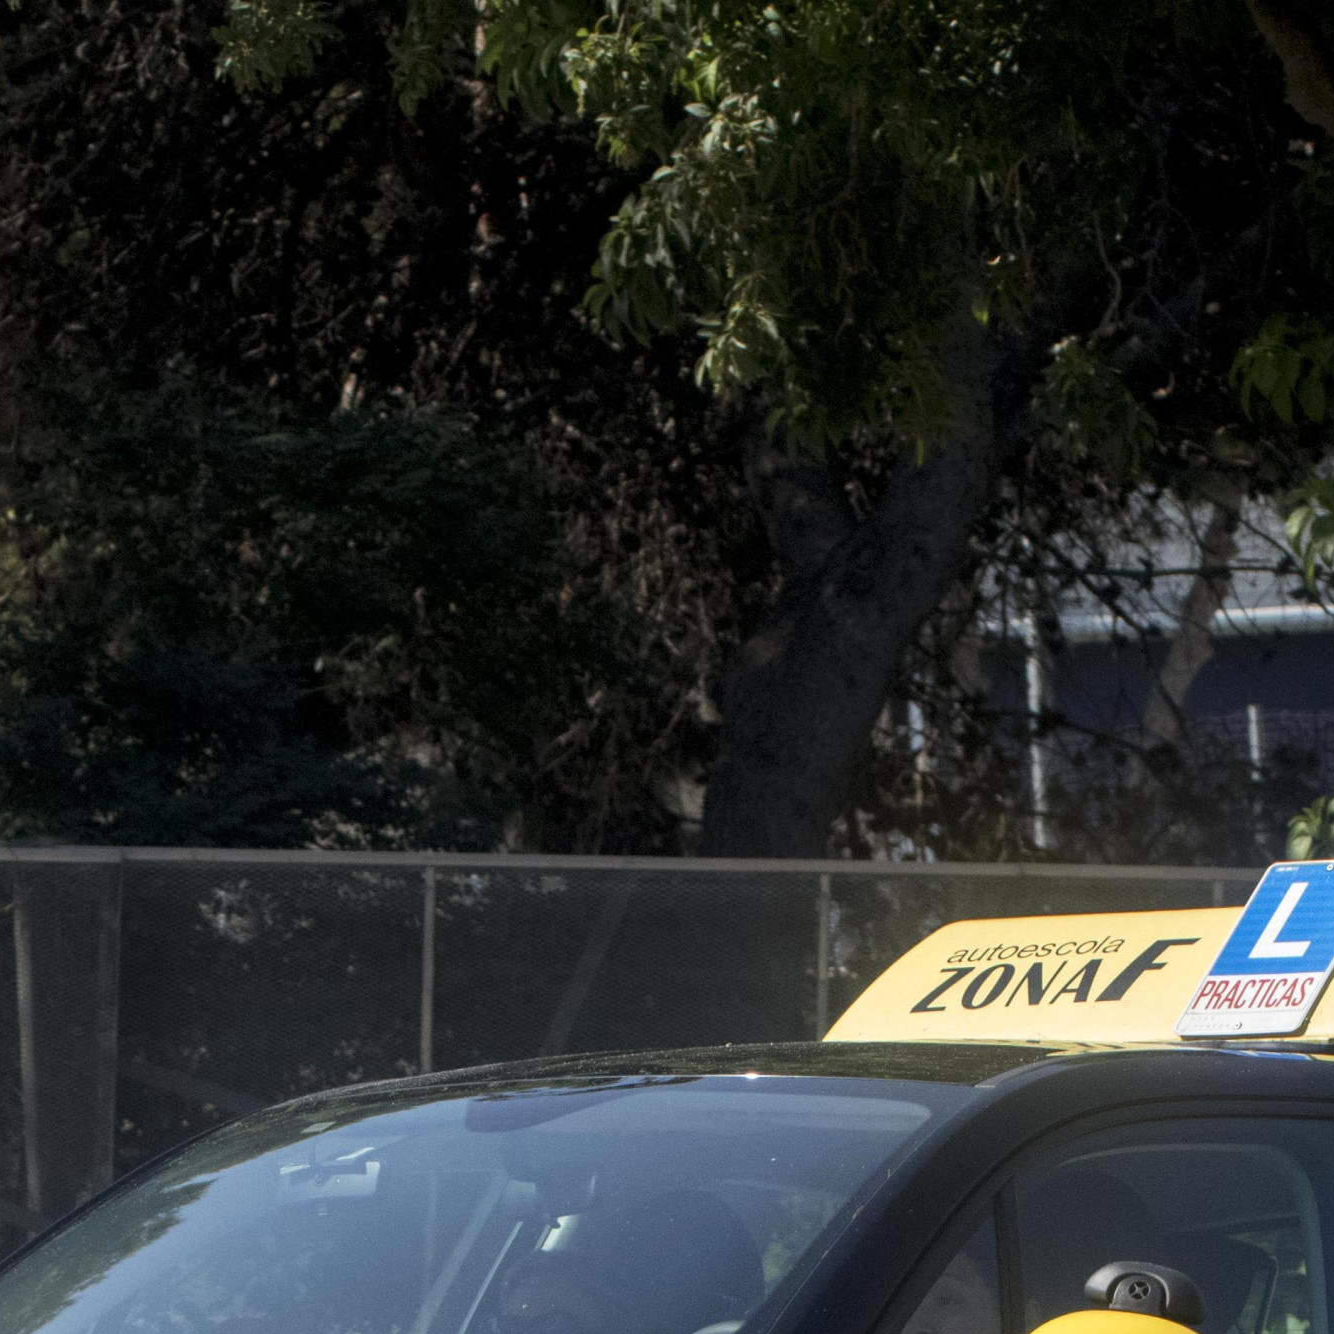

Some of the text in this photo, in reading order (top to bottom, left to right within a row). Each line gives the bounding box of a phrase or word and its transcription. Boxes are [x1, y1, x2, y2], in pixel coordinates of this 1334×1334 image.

[1248, 882, 1312, 958] L
[946, 935, 1125, 964] autoescola
[1191, 977, 1315, 1010] PRACTICAS
